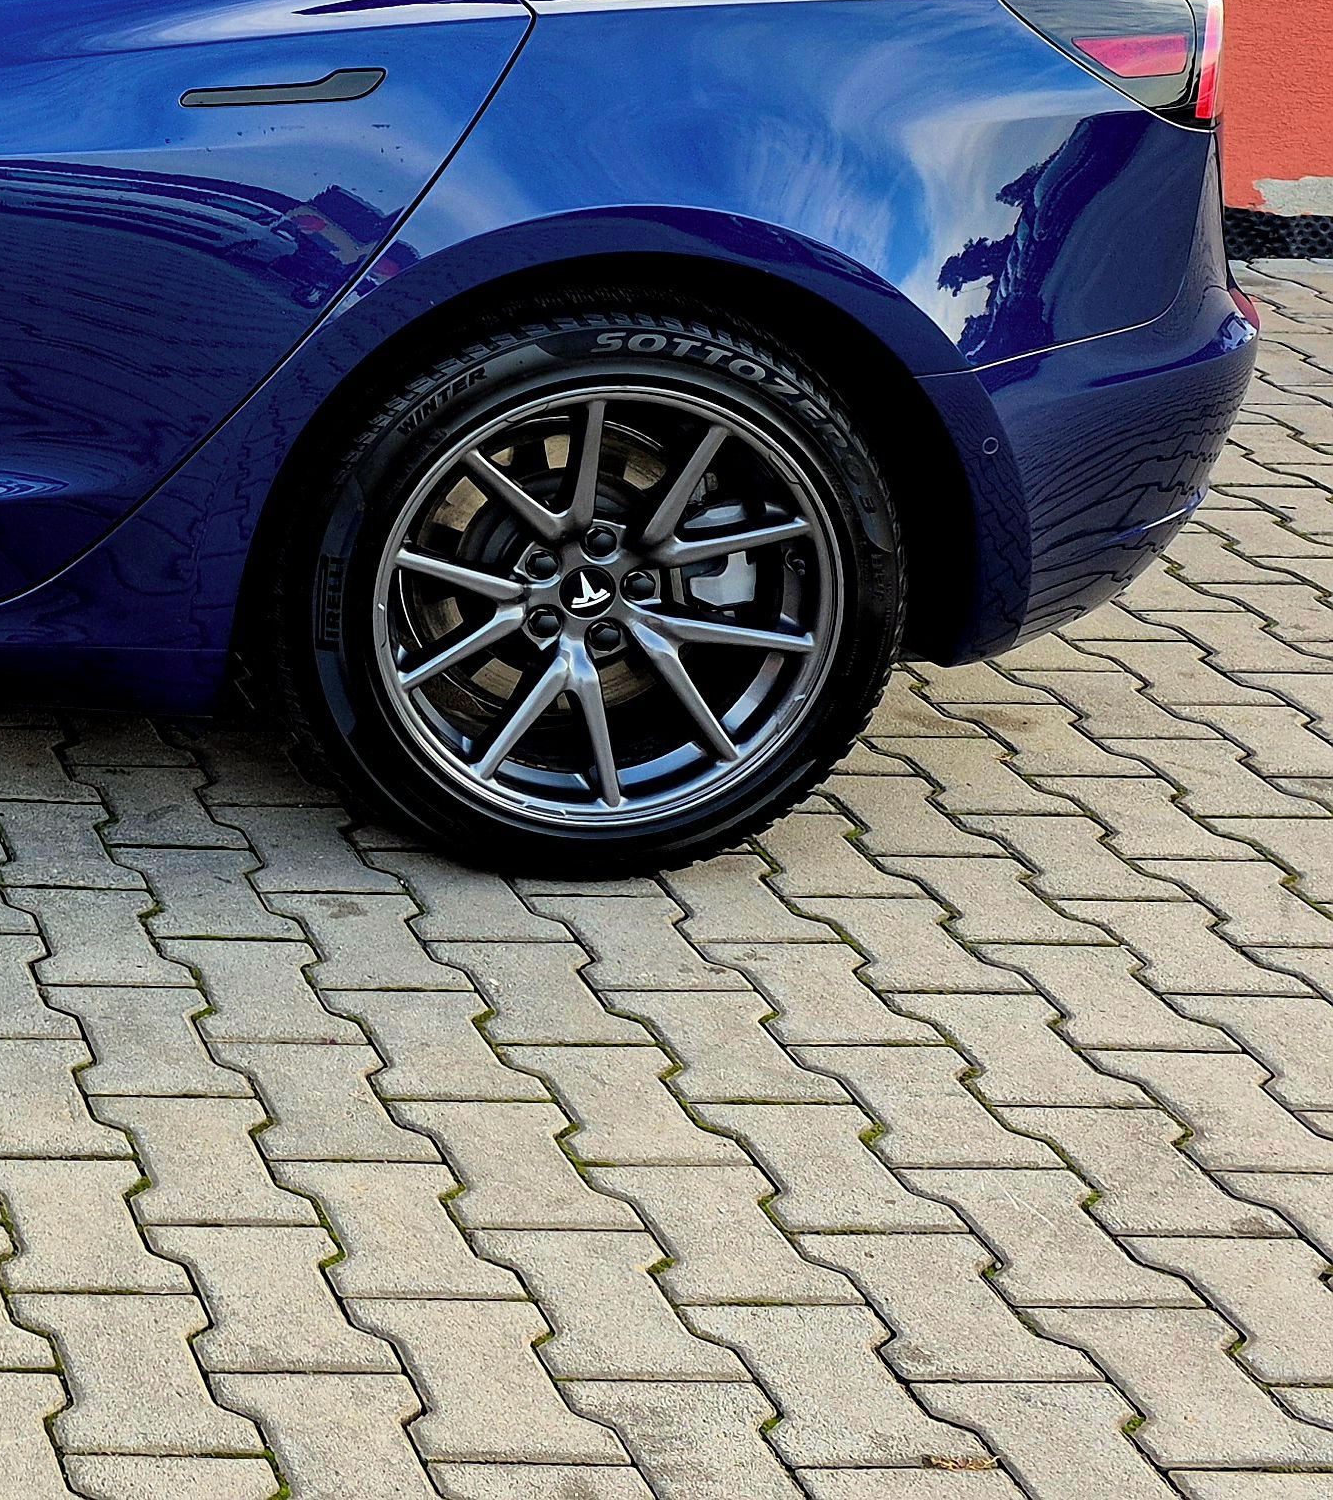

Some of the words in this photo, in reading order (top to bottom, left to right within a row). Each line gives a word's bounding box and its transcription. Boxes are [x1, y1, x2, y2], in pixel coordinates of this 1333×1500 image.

[397, 367, 488, 435] WINTER
[589, 331, 868, 485] SOTTOZERO
[315, 556, 344, 652] PIRELLI
